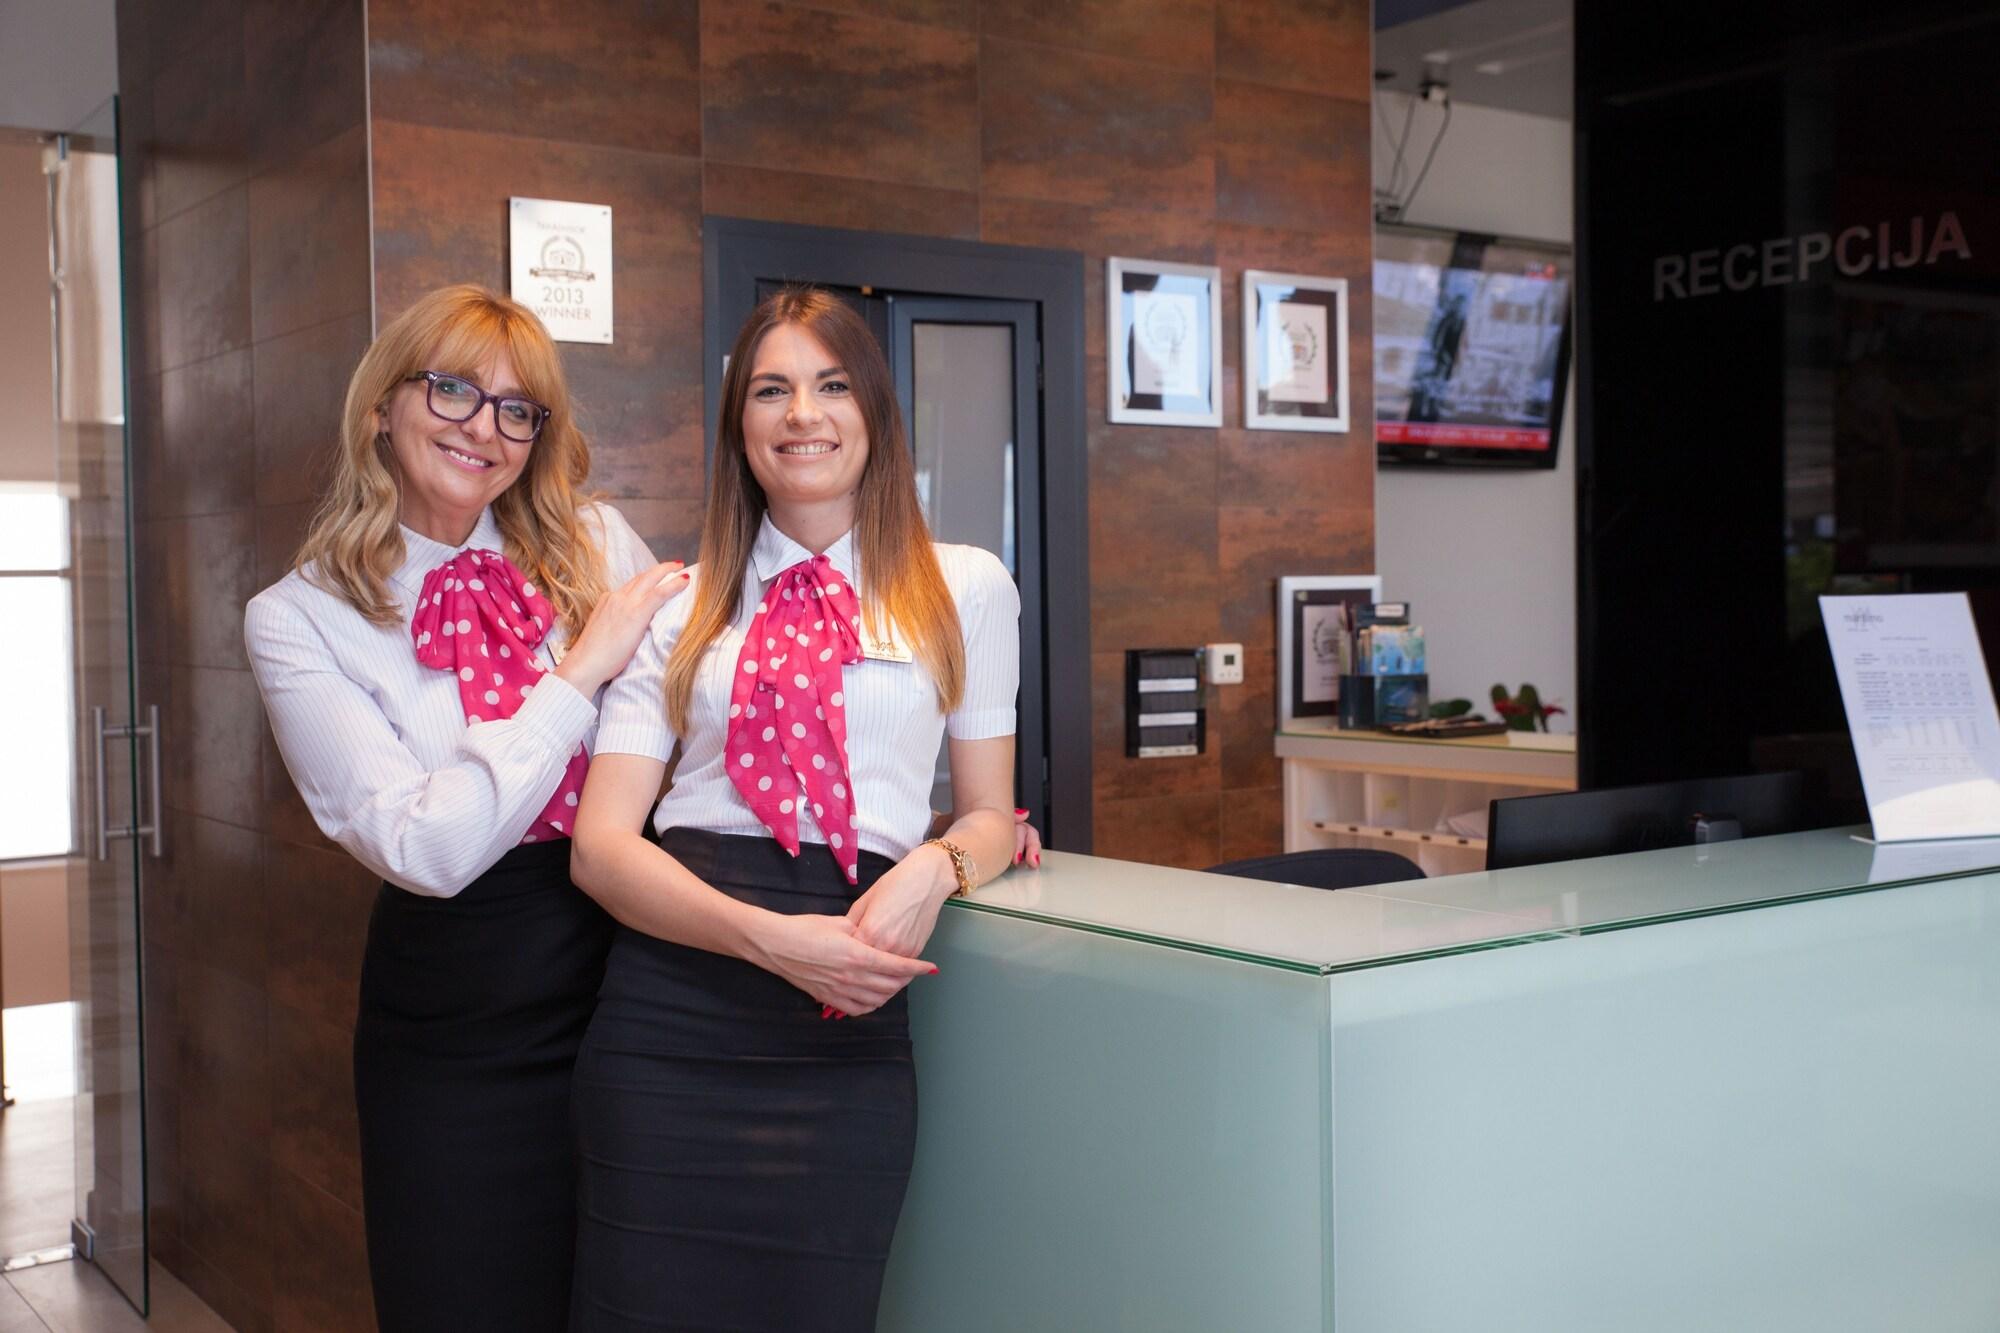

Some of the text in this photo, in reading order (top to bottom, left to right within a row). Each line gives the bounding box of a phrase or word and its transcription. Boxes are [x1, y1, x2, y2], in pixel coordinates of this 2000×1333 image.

[1652, 210, 1972, 303] RECEPCIJA
[543, 287, 584, 304] 2013
[536, 306, 592, 321] WINNER
